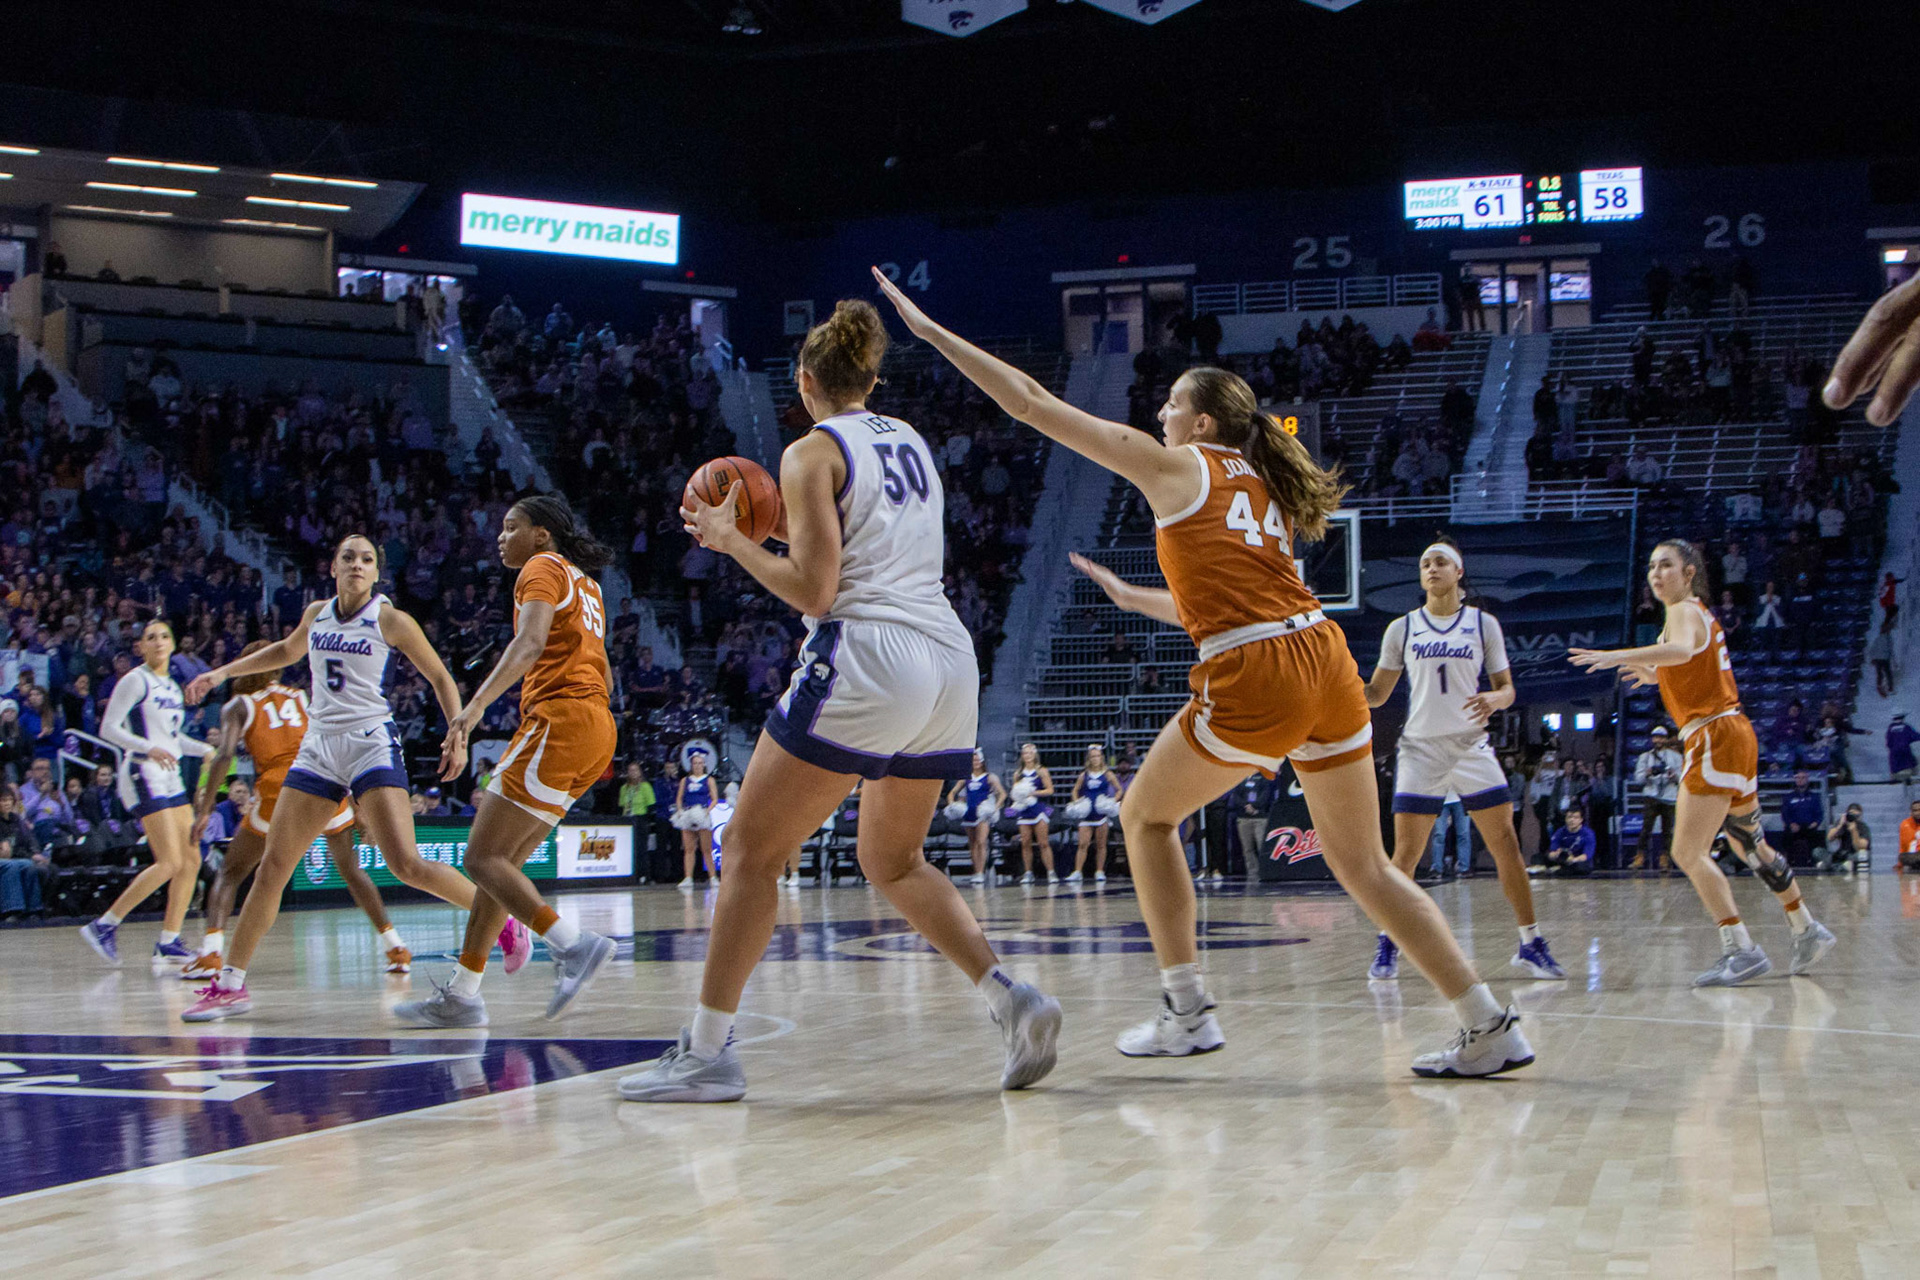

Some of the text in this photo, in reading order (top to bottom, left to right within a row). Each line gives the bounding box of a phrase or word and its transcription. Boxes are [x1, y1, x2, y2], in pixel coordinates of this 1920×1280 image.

[1468, 178, 1514, 189] K-STATE
[1596, 171, 1624, 180] TEXAS
[1409, 197, 1459, 210] maids
[1411, 186, 1461, 198] merry
[1594, 187, 1628, 209] 58
[1474, 194, 1504, 217] 61
[468, 209, 672, 248] merry maids
[1441, 215, 1461, 228] PM
[1703, 213, 1766, 248] 26
[1293, 235, 1351, 270] 25
[860, 416, 897, 434] LEE
[872, 443, 929, 505] 50
[1226, 491, 1290, 556] 44
[579, 586, 604, 639] 35
[311, 631, 373, 656] Wildcats
[1412, 641, 1473, 660] Wildcats
[326, 658, 346, 693] 5
[1437, 663, 1448, 695] 1
[262, 698, 302, 729] 14
